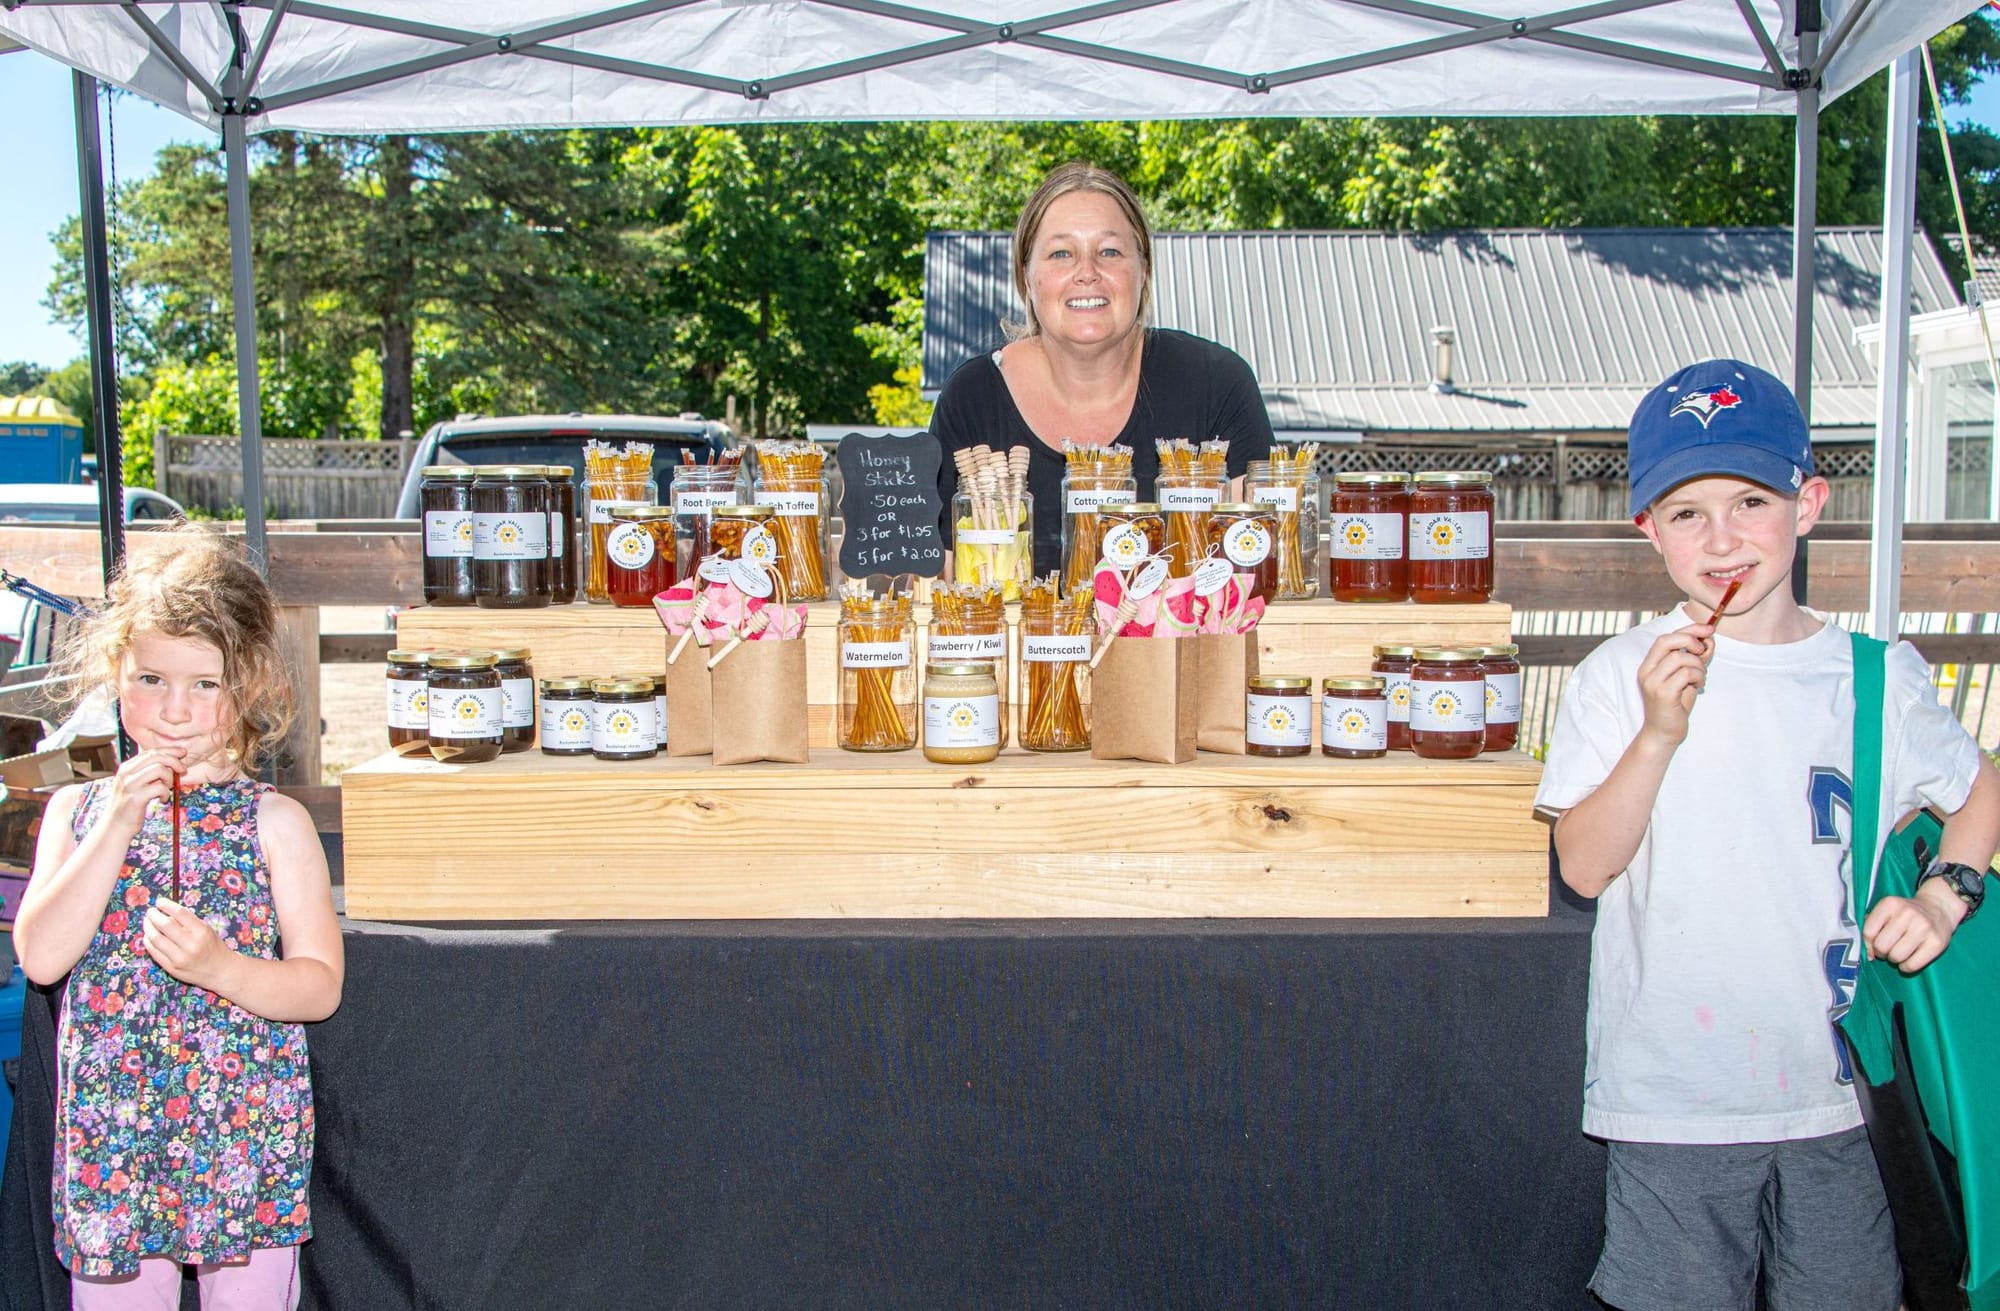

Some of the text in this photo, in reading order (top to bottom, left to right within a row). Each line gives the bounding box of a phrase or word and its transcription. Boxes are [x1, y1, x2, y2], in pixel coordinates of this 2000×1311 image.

[860, 449, 911, 473] Honey
[865, 470, 916, 486] Sticks
[682, 498, 728, 507] Root Beer
[785, 500, 815, 510] Toffee
[870, 494, 927, 508] .50 each
[1074, 497, 1104, 506] Cotton
[1168, 494, 1214, 504] Cinnamon
[877, 512, 896, 522] OR
[1340, 516, 1374, 534] CEDAR VALLEY
[493, 519, 524, 535] CEDAR VALLEY
[856, 524, 934, 542] 3 for $1.25
[1426, 516, 1441, 535] CEDAR
[858, 546, 940, 566] 5 for $2.00
[929, 641, 974, 651] Strawberry
[984, 638, 1002, 649] Kiwi
[1028, 645, 1086, 655] Butterscotch
[845, 651, 903, 661] Watermelon
[452, 694, 486, 711] CEDAR VALLEY
[1428, 689, 1462, 706] CEDAR VALLEY
[560, 708, 573, 723] CEDAR
[605, 708, 620, 724] CEDAR
[622, 708, 639, 724] VALLEY
[1262, 704, 1296, 721] CEDAR VALLEY
[1337, 707, 1371, 725] CEDAR VALLEY
